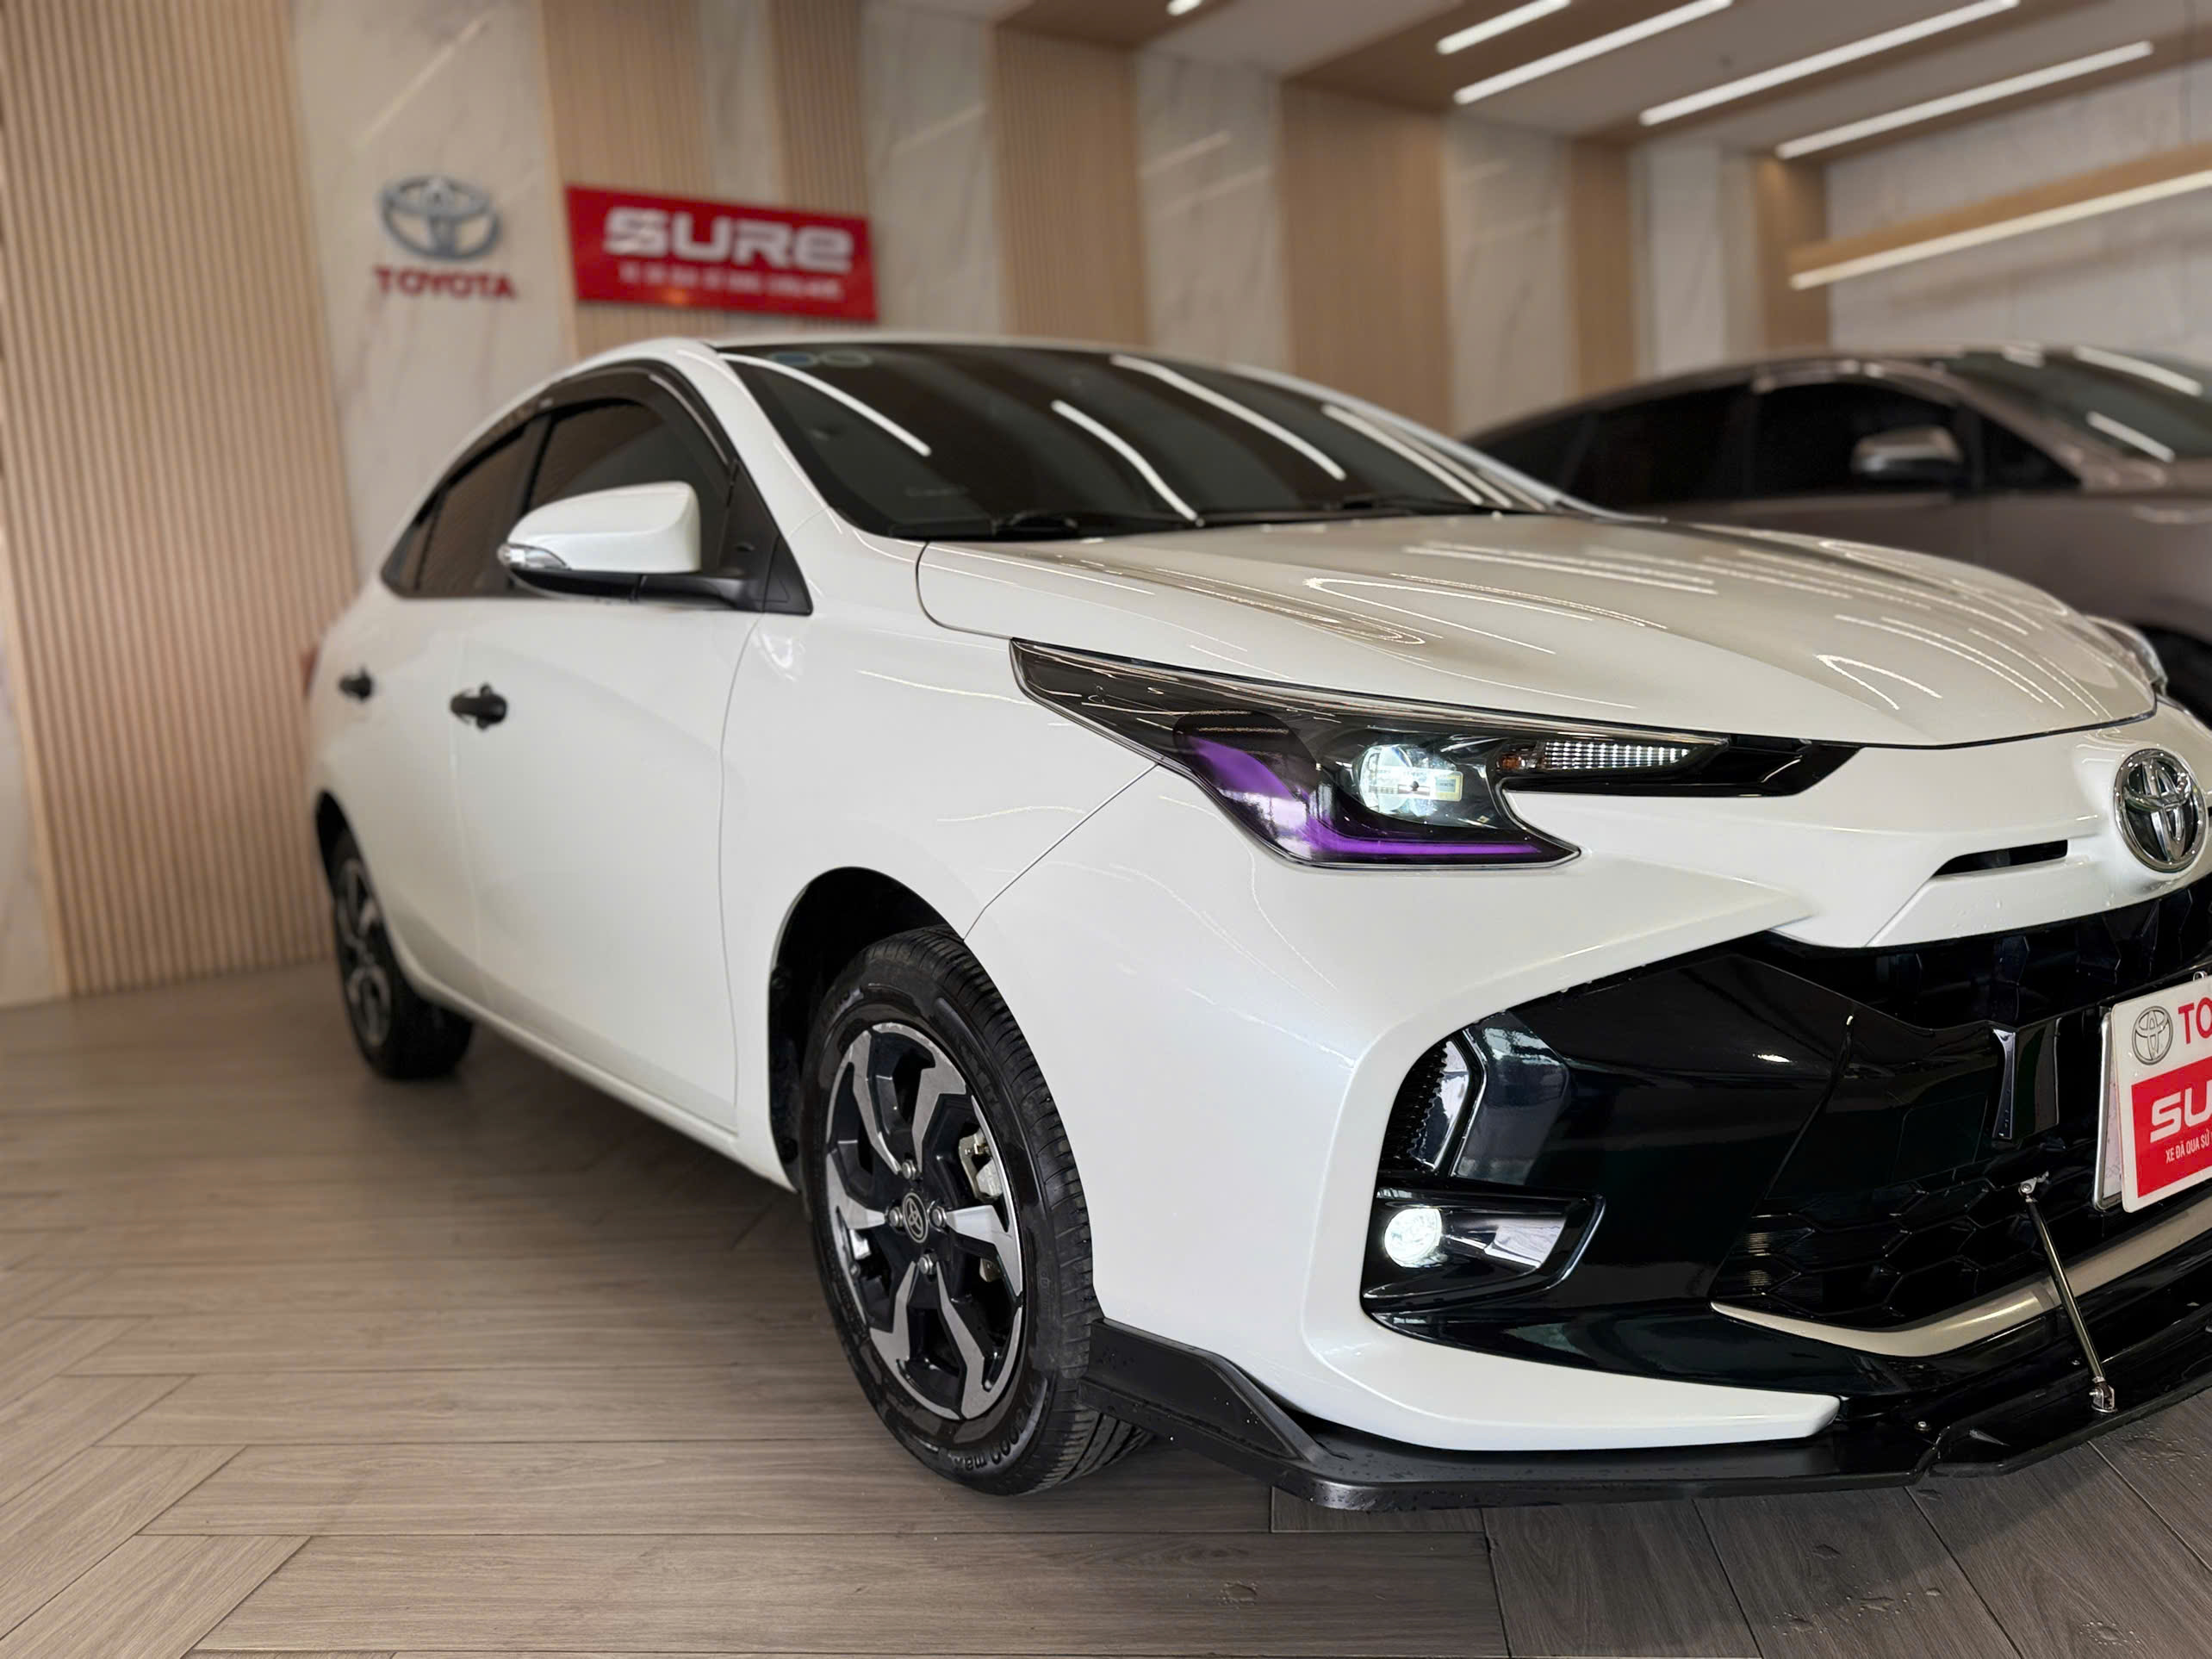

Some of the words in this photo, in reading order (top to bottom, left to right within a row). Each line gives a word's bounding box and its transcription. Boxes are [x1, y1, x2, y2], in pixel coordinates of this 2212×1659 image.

[372, 266, 518, 299] TOYOTA
[2165, 1146, 2175, 1164] XE
[2185, 1136, 2200, 1155] QUA
